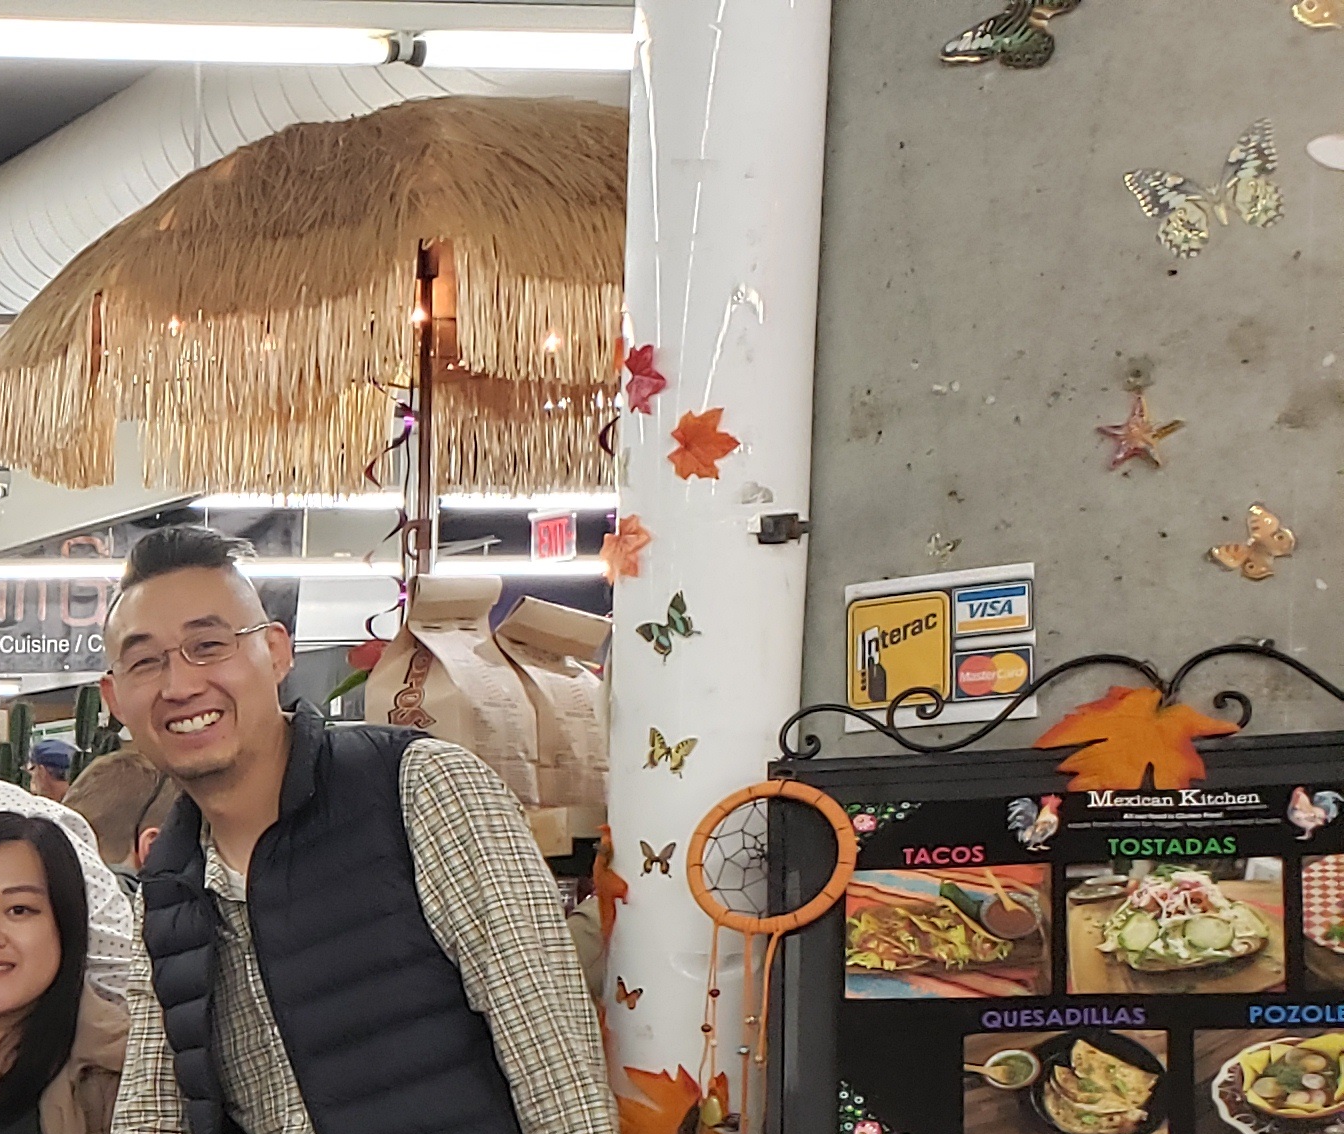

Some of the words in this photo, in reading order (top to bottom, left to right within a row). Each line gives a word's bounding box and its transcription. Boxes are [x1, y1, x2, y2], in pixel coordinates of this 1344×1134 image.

[538, 518, 568, 558] EXIT
[968, 599, 1014, 619] VISA
[0, 634, 70, 654] Cuisine
[861, 612, 938, 671] Interac
[960, 666, 1025, 683] MasterCard
[1086, 790, 1175, 808] Mexican
[1177, 789, 1261, 807] Kitchen
[902, 844, 985, 865] TACOS
[1108, 836, 1237, 857] TOSTADAS
[981, 1006, 1146, 1029] QUESADILLAS
[1249, 1004, 1344, 1025] POZOLE
